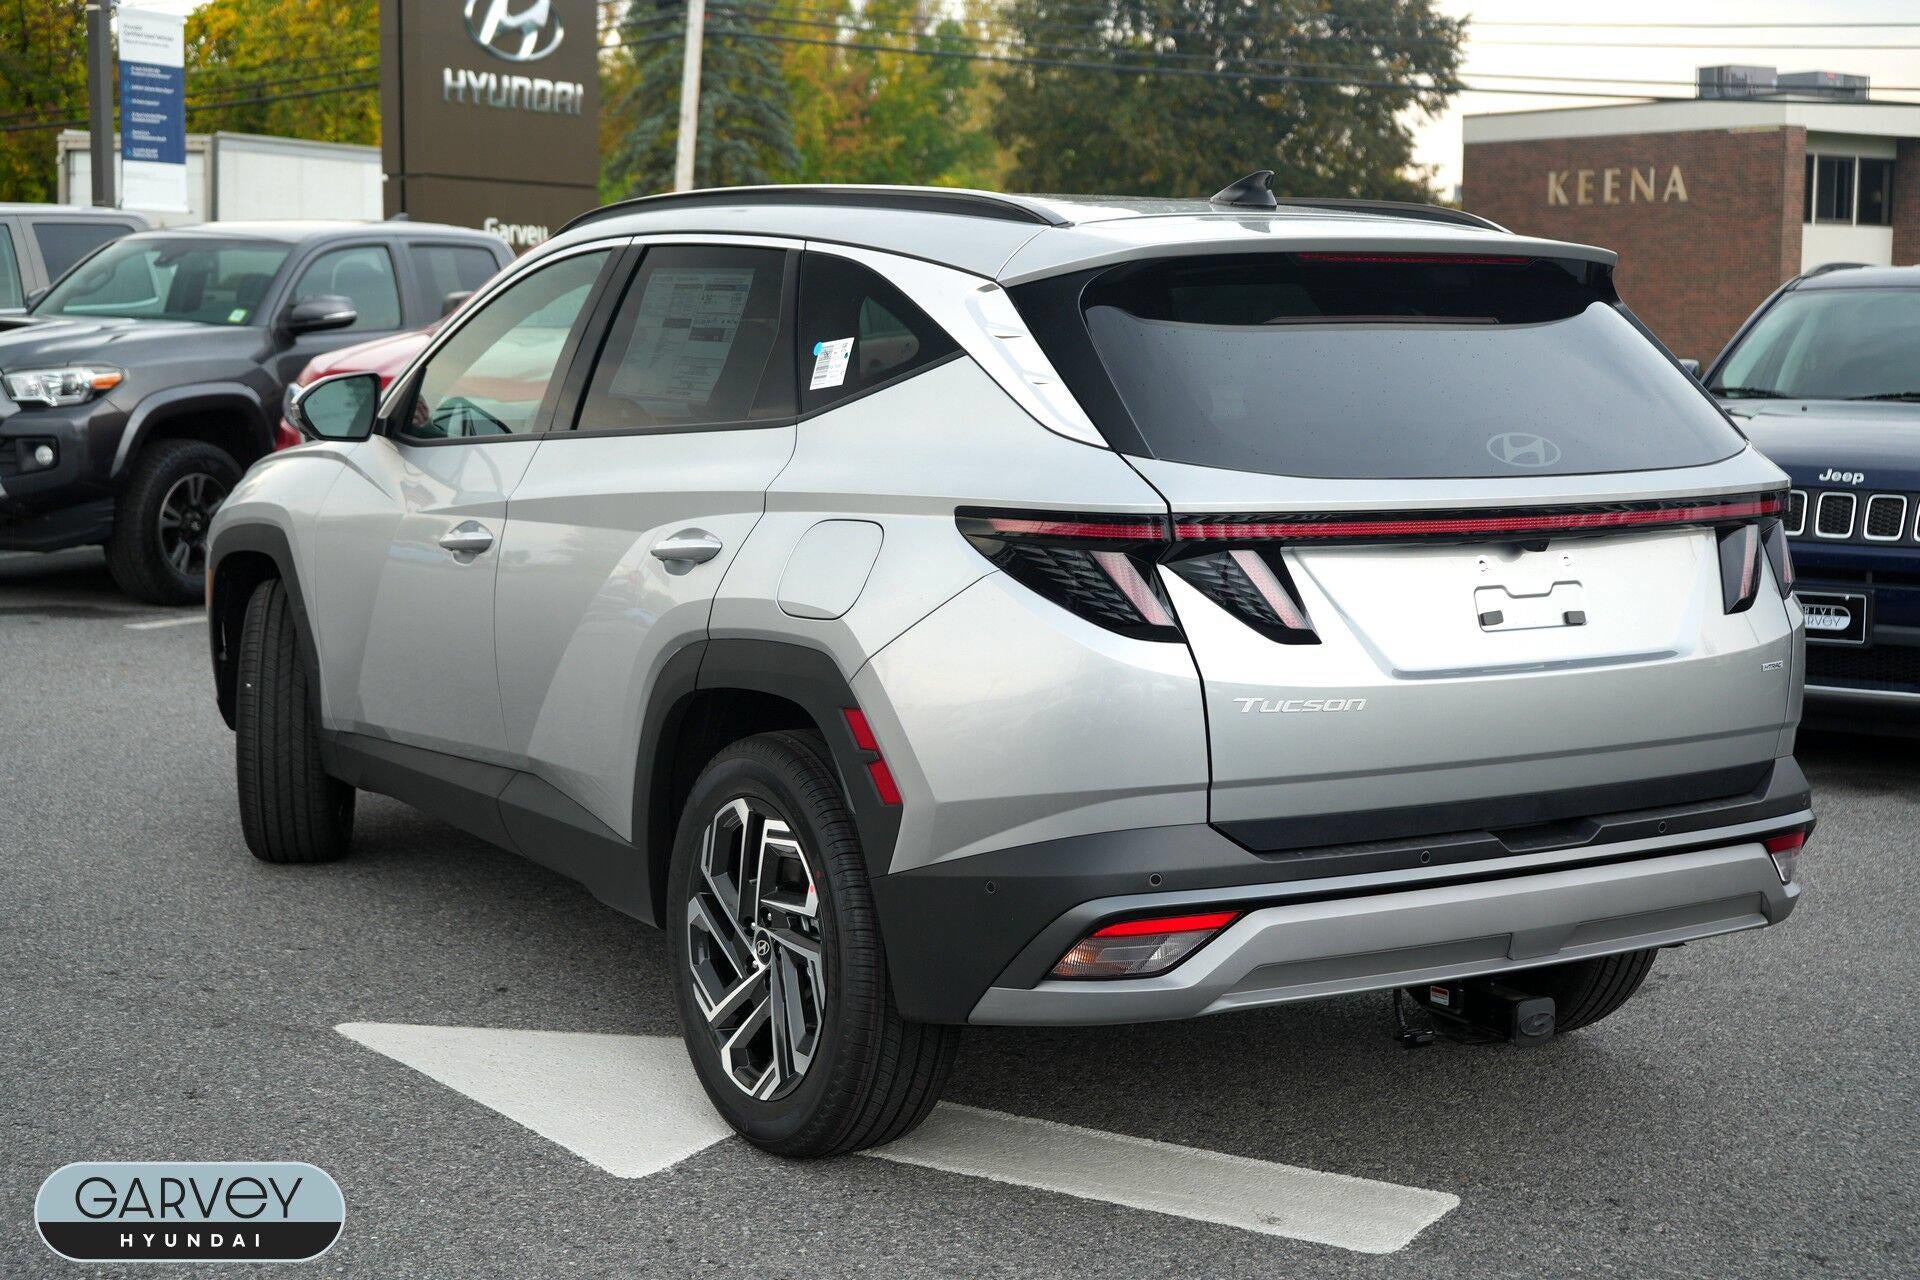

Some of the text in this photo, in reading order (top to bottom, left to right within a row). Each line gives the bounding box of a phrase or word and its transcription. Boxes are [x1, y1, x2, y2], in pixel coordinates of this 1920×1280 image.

[443, 67, 584, 115] HYUNDAI
[1548, 164, 1688, 206] KEENA
[1819, 468, 1865, 486] Jeep
